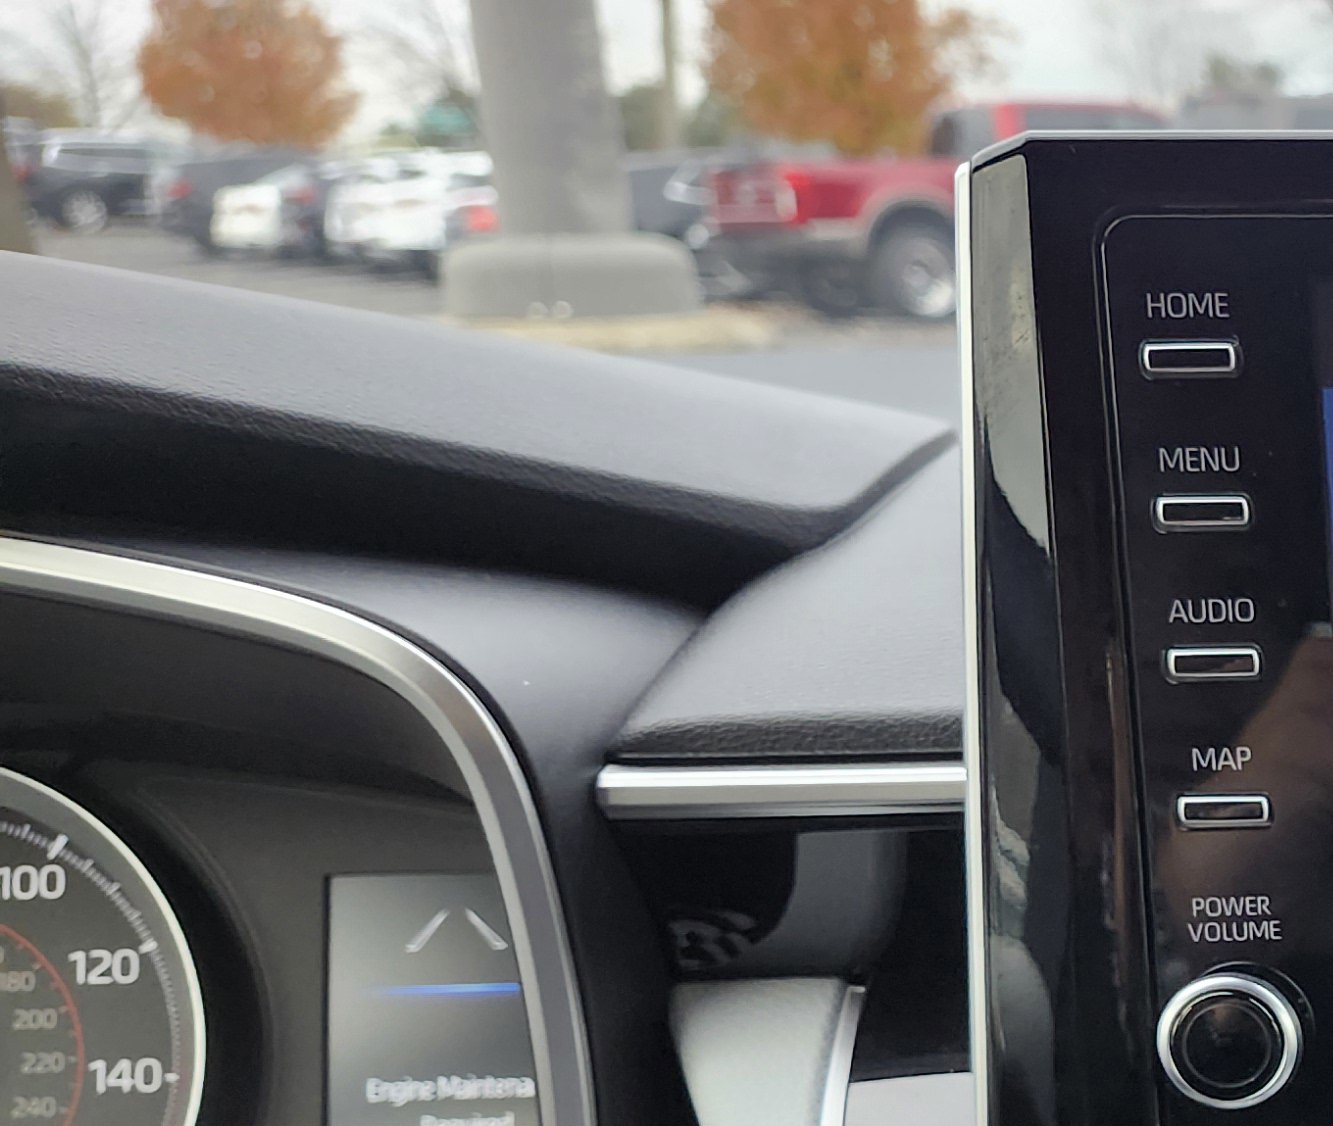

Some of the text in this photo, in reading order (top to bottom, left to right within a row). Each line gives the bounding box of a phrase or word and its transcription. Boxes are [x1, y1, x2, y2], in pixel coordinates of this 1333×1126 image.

[1145, 291, 1230, 318] HOME
[1158, 446, 1241, 473] MENU
[1168, 597, 1255, 623] AUDIO
[1190, 746, 1252, 772] MAP
[0, 863, 66, 901] 100
[1191, 895, 1272, 917] POWER
[1187, 919, 1282, 943] VOLUME
[67, 948, 141, 986] 120
[11, 1008, 57, 1031] 200
[20, 1051, 66, 1073] 220
[88, 1057, 163, 1094] 140
[366, 1076, 437, 1107] Engine
[10, 1096, 56, 1120] 240
